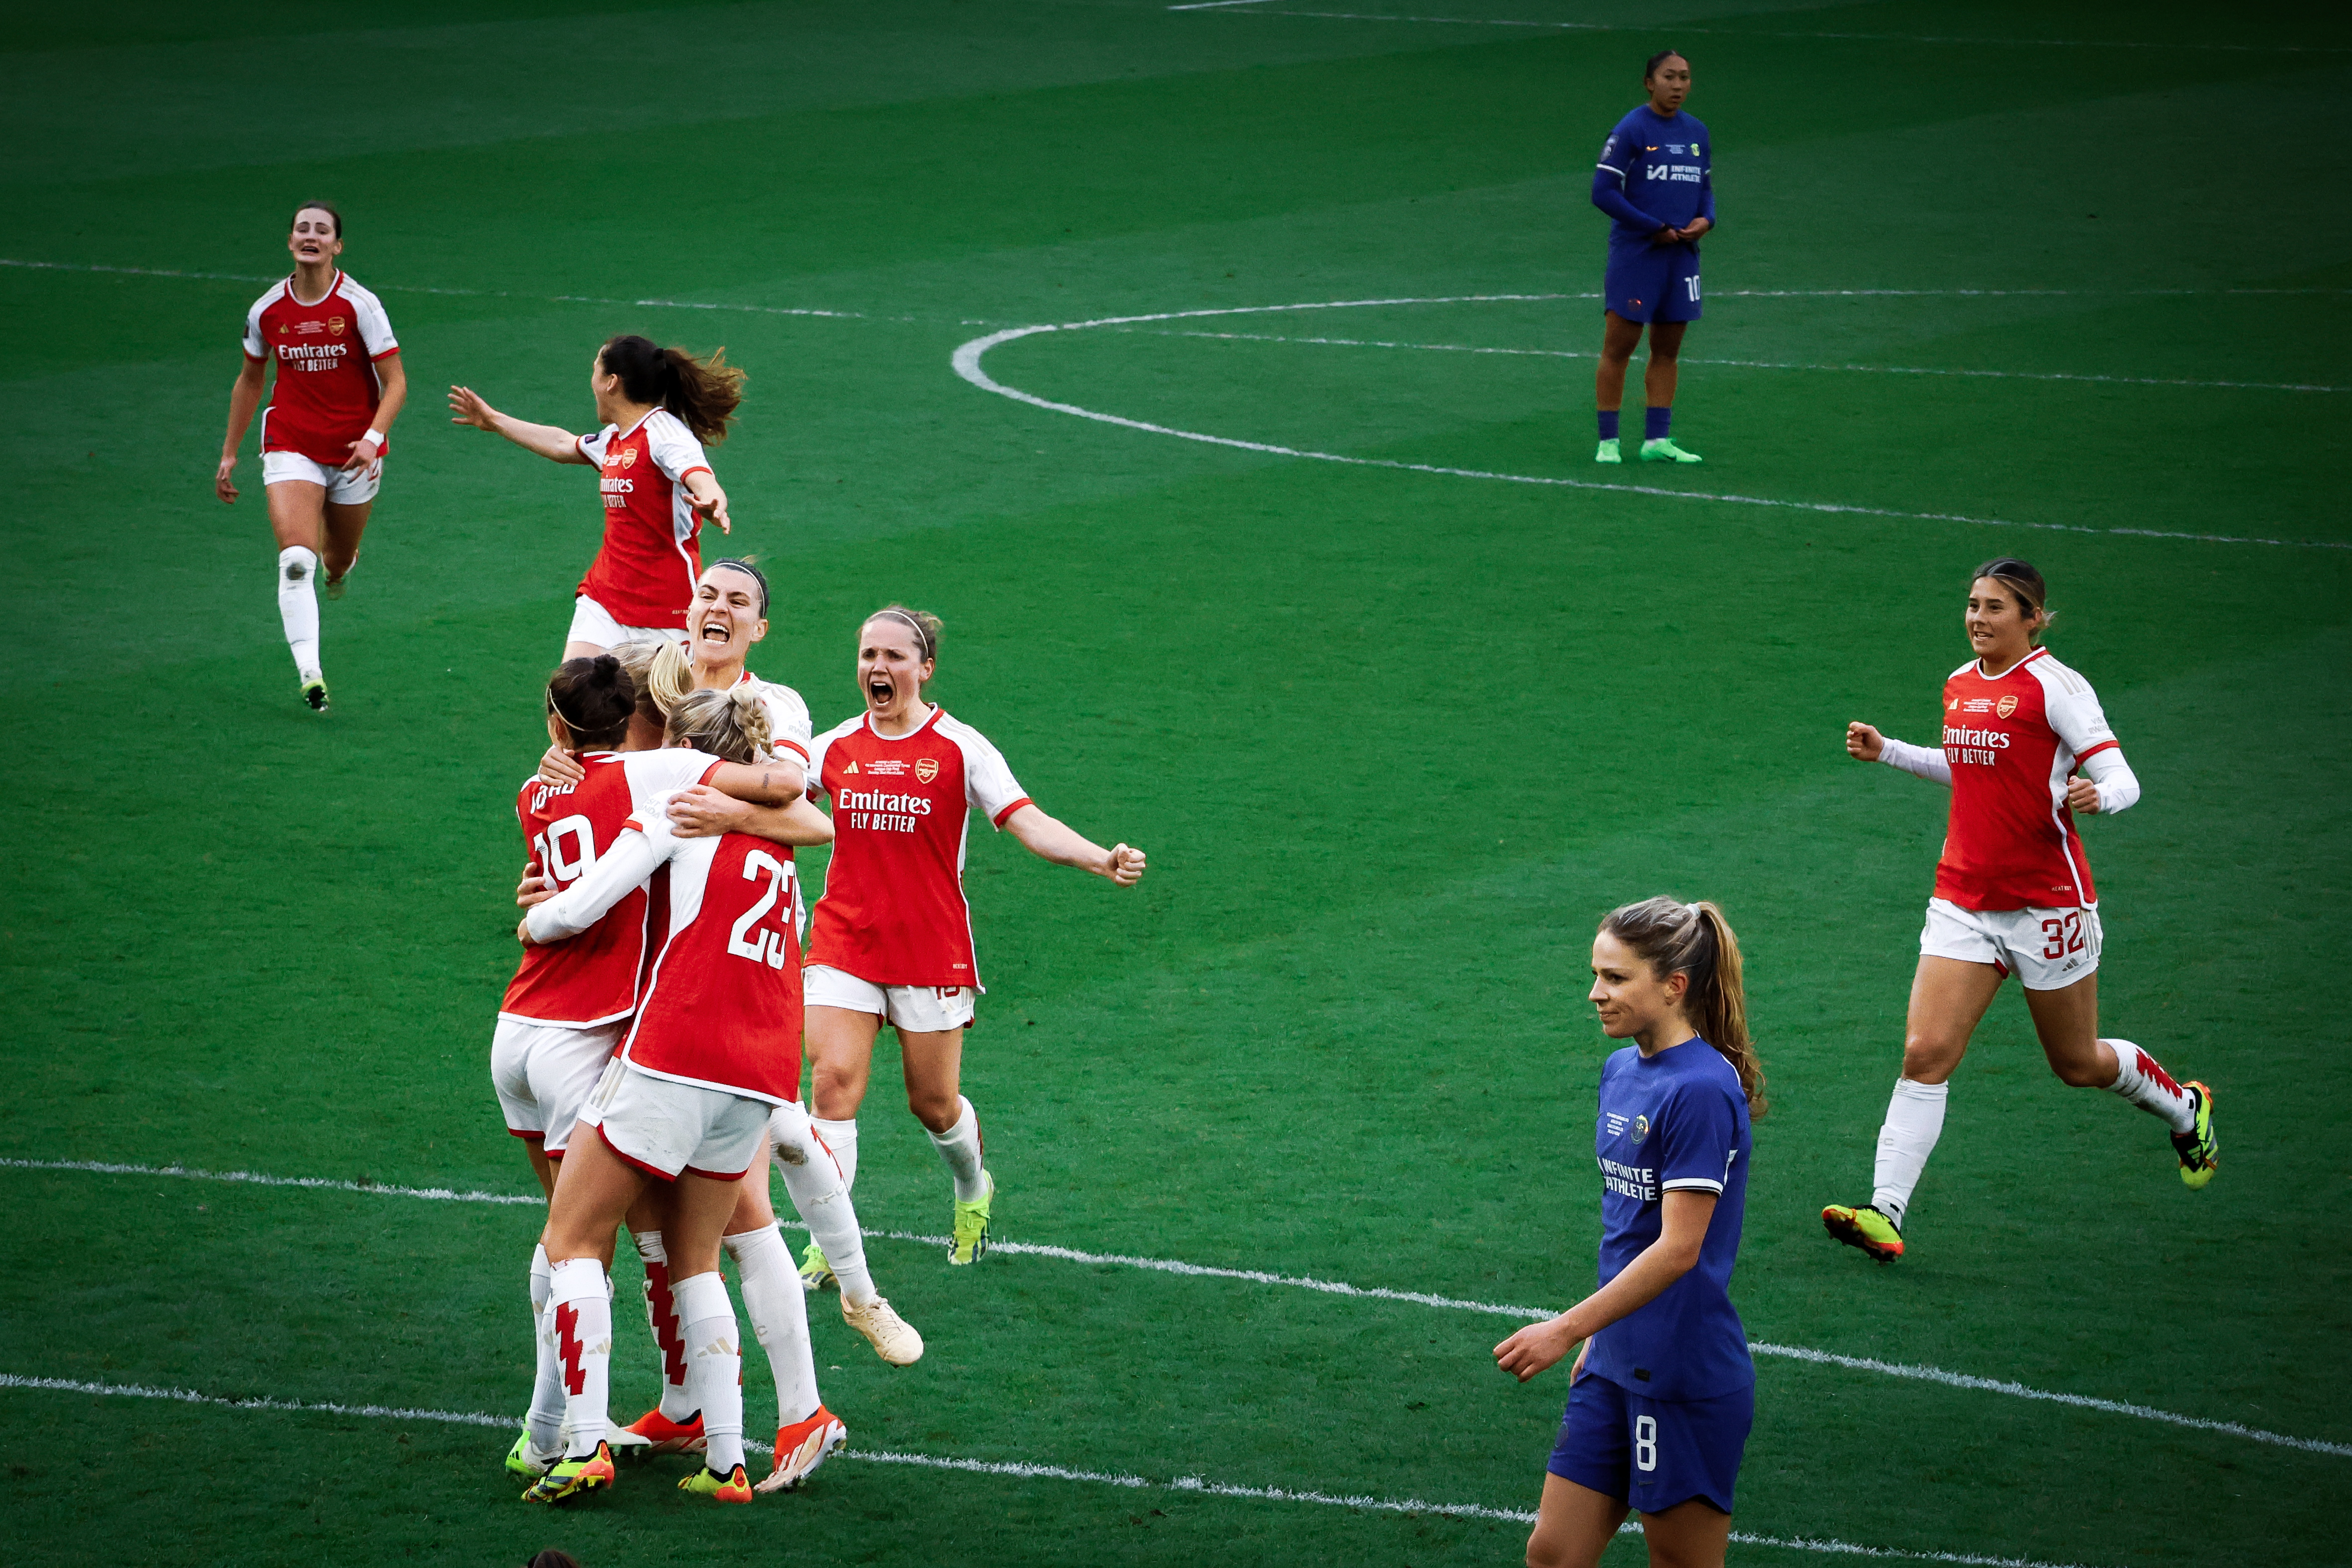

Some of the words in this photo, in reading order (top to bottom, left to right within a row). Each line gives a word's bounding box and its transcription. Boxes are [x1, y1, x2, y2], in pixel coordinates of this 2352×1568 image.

[1685, 275, 1700, 302] 10
[279, 343, 347, 359] Emirates
[600, 474, 634, 493] mirates
[1943, 724, 2010, 749] Emirates
[1947, 747, 1959, 764] FLY
[1962, 748, 1995, 766] BETTER
[840, 788, 931, 815] Emirates
[851, 812, 869, 829] FLY
[872, 813, 916, 833] BETTER
[727, 849, 795, 970] 23
[2042, 912, 2084, 959] 32
[1602, 1157, 1654, 1183] INFINITE
[1606, 1176, 1657, 1201] ATHLETE
[1636, 1415, 1657, 1471] 8
